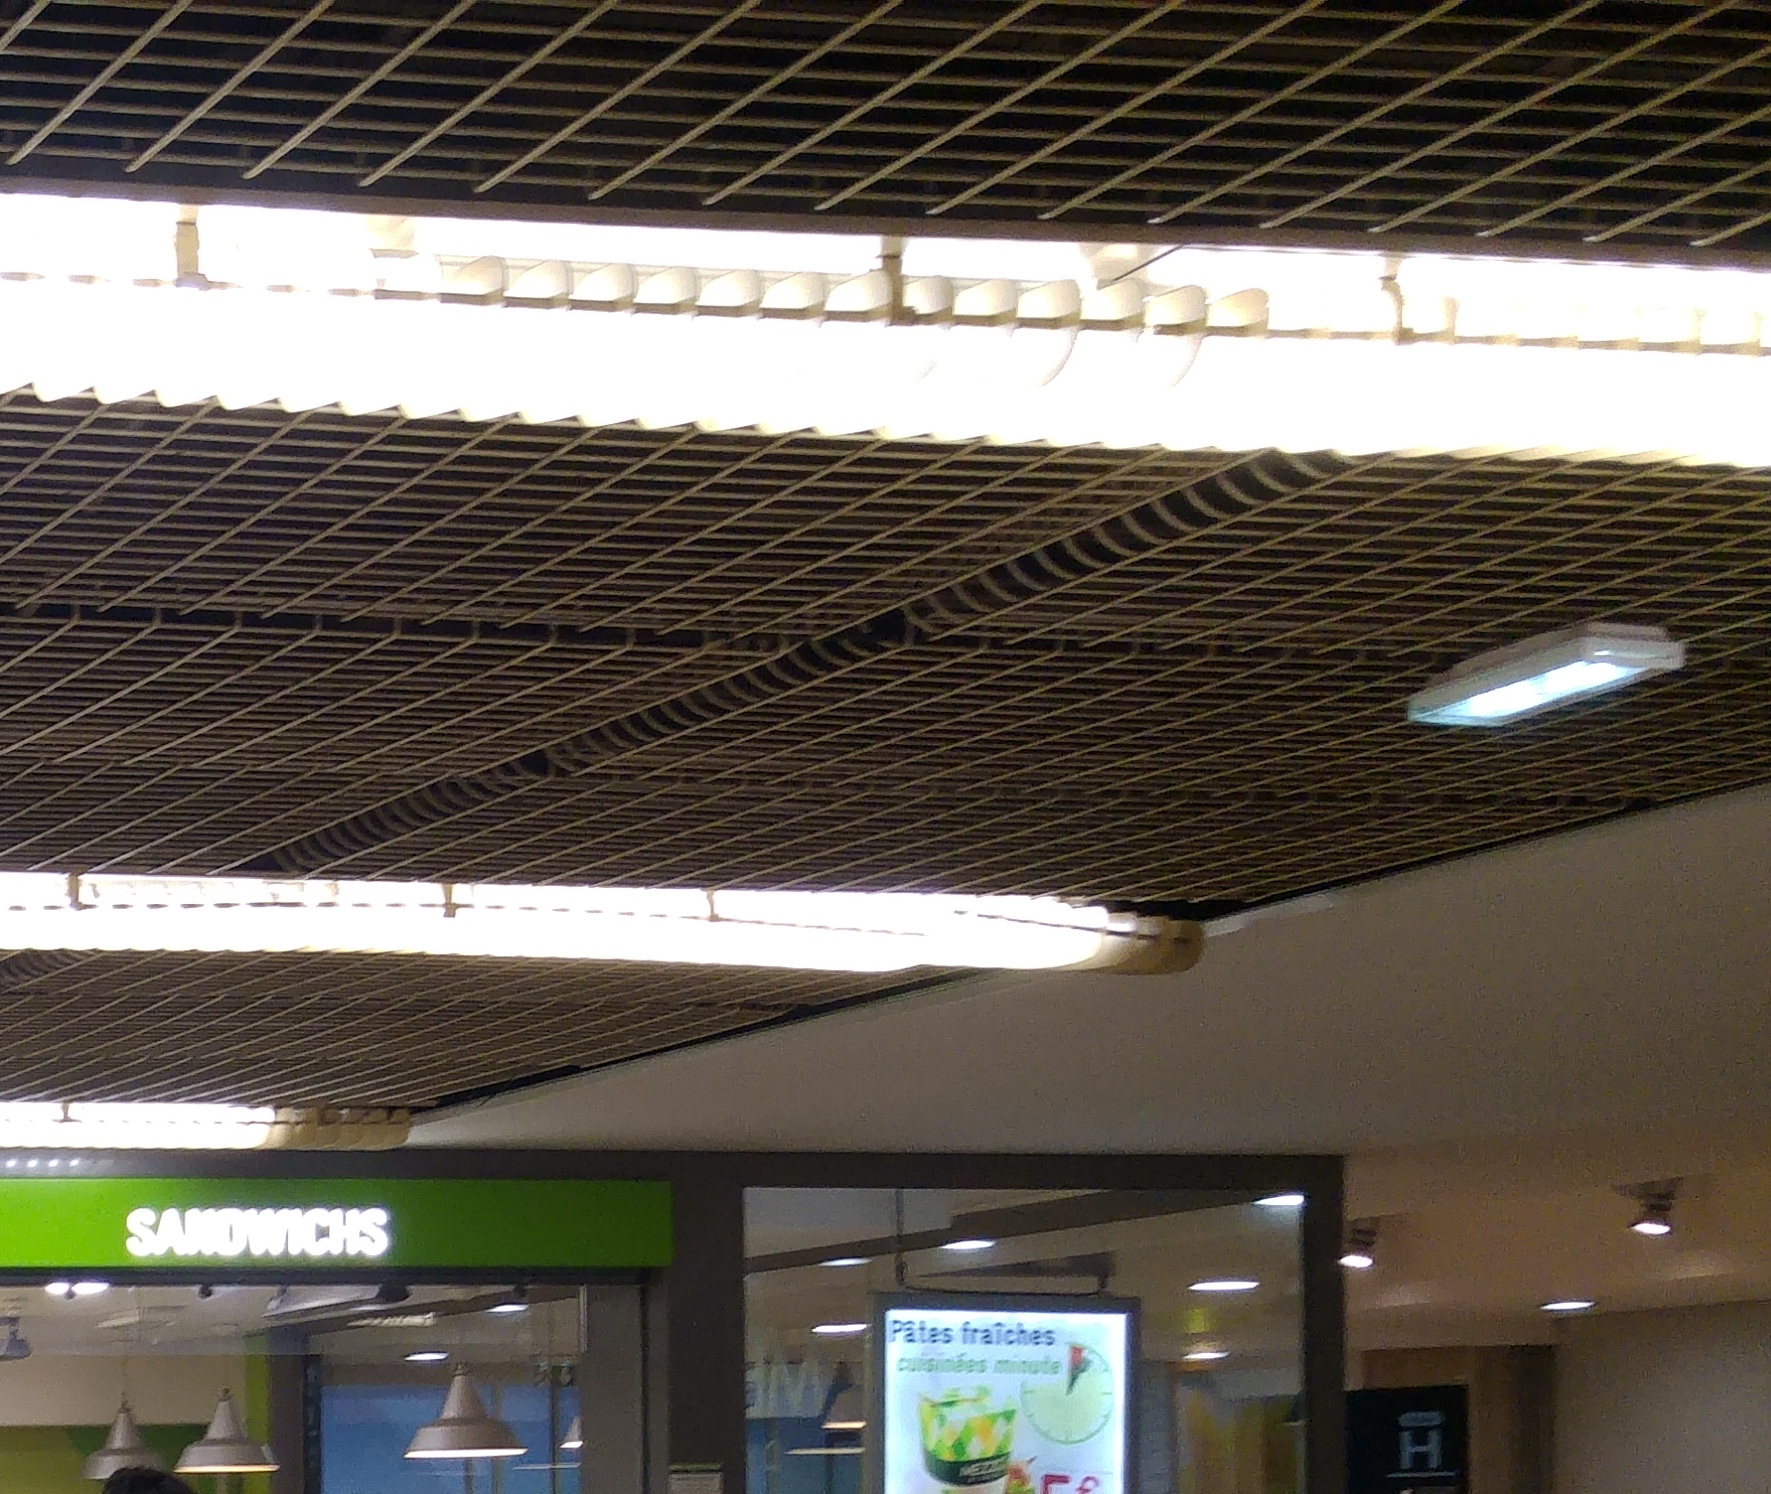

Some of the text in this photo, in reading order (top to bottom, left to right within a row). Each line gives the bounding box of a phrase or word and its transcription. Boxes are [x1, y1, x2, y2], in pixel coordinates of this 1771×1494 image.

[125, 1206, 390, 1257] SANDWICHS
[889, 1320, 1056, 1347] Pâtes fraîches
